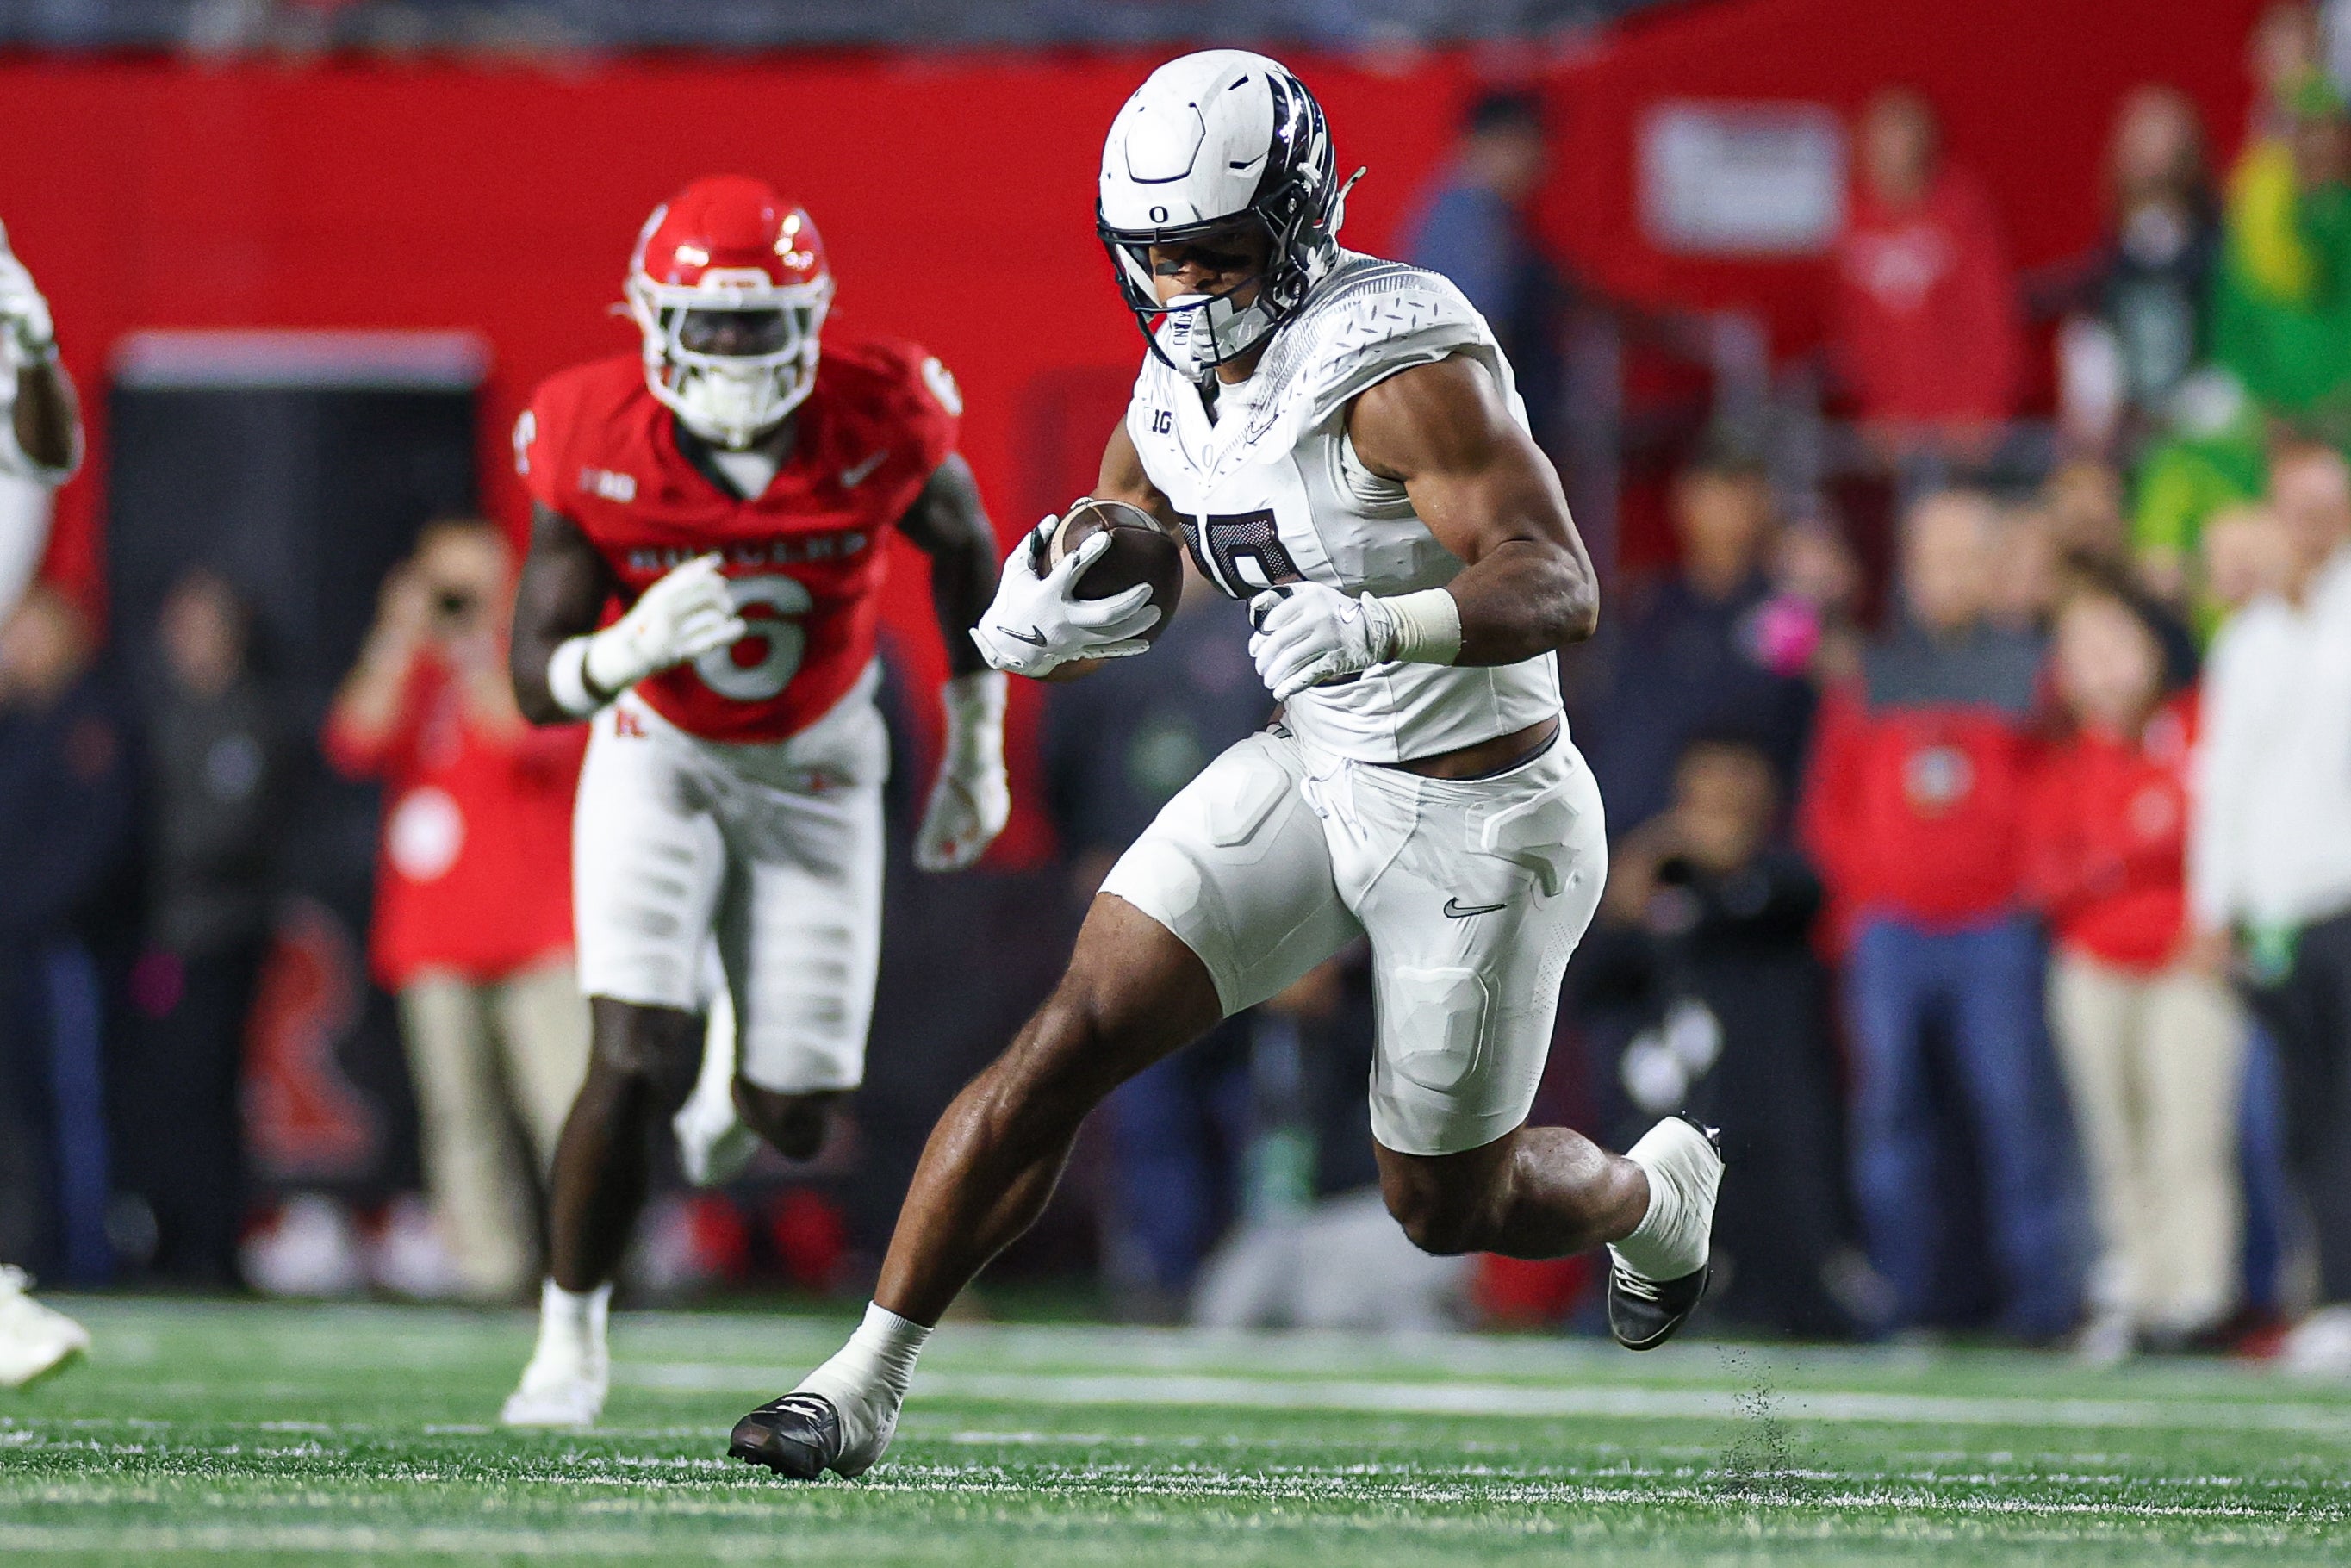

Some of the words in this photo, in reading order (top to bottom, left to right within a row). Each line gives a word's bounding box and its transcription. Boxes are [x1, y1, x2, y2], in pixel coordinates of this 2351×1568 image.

[1149, 206, 1169, 224] O
[1172, 310, 1194, 345] XTRND
[693, 574, 813, 702] 6
